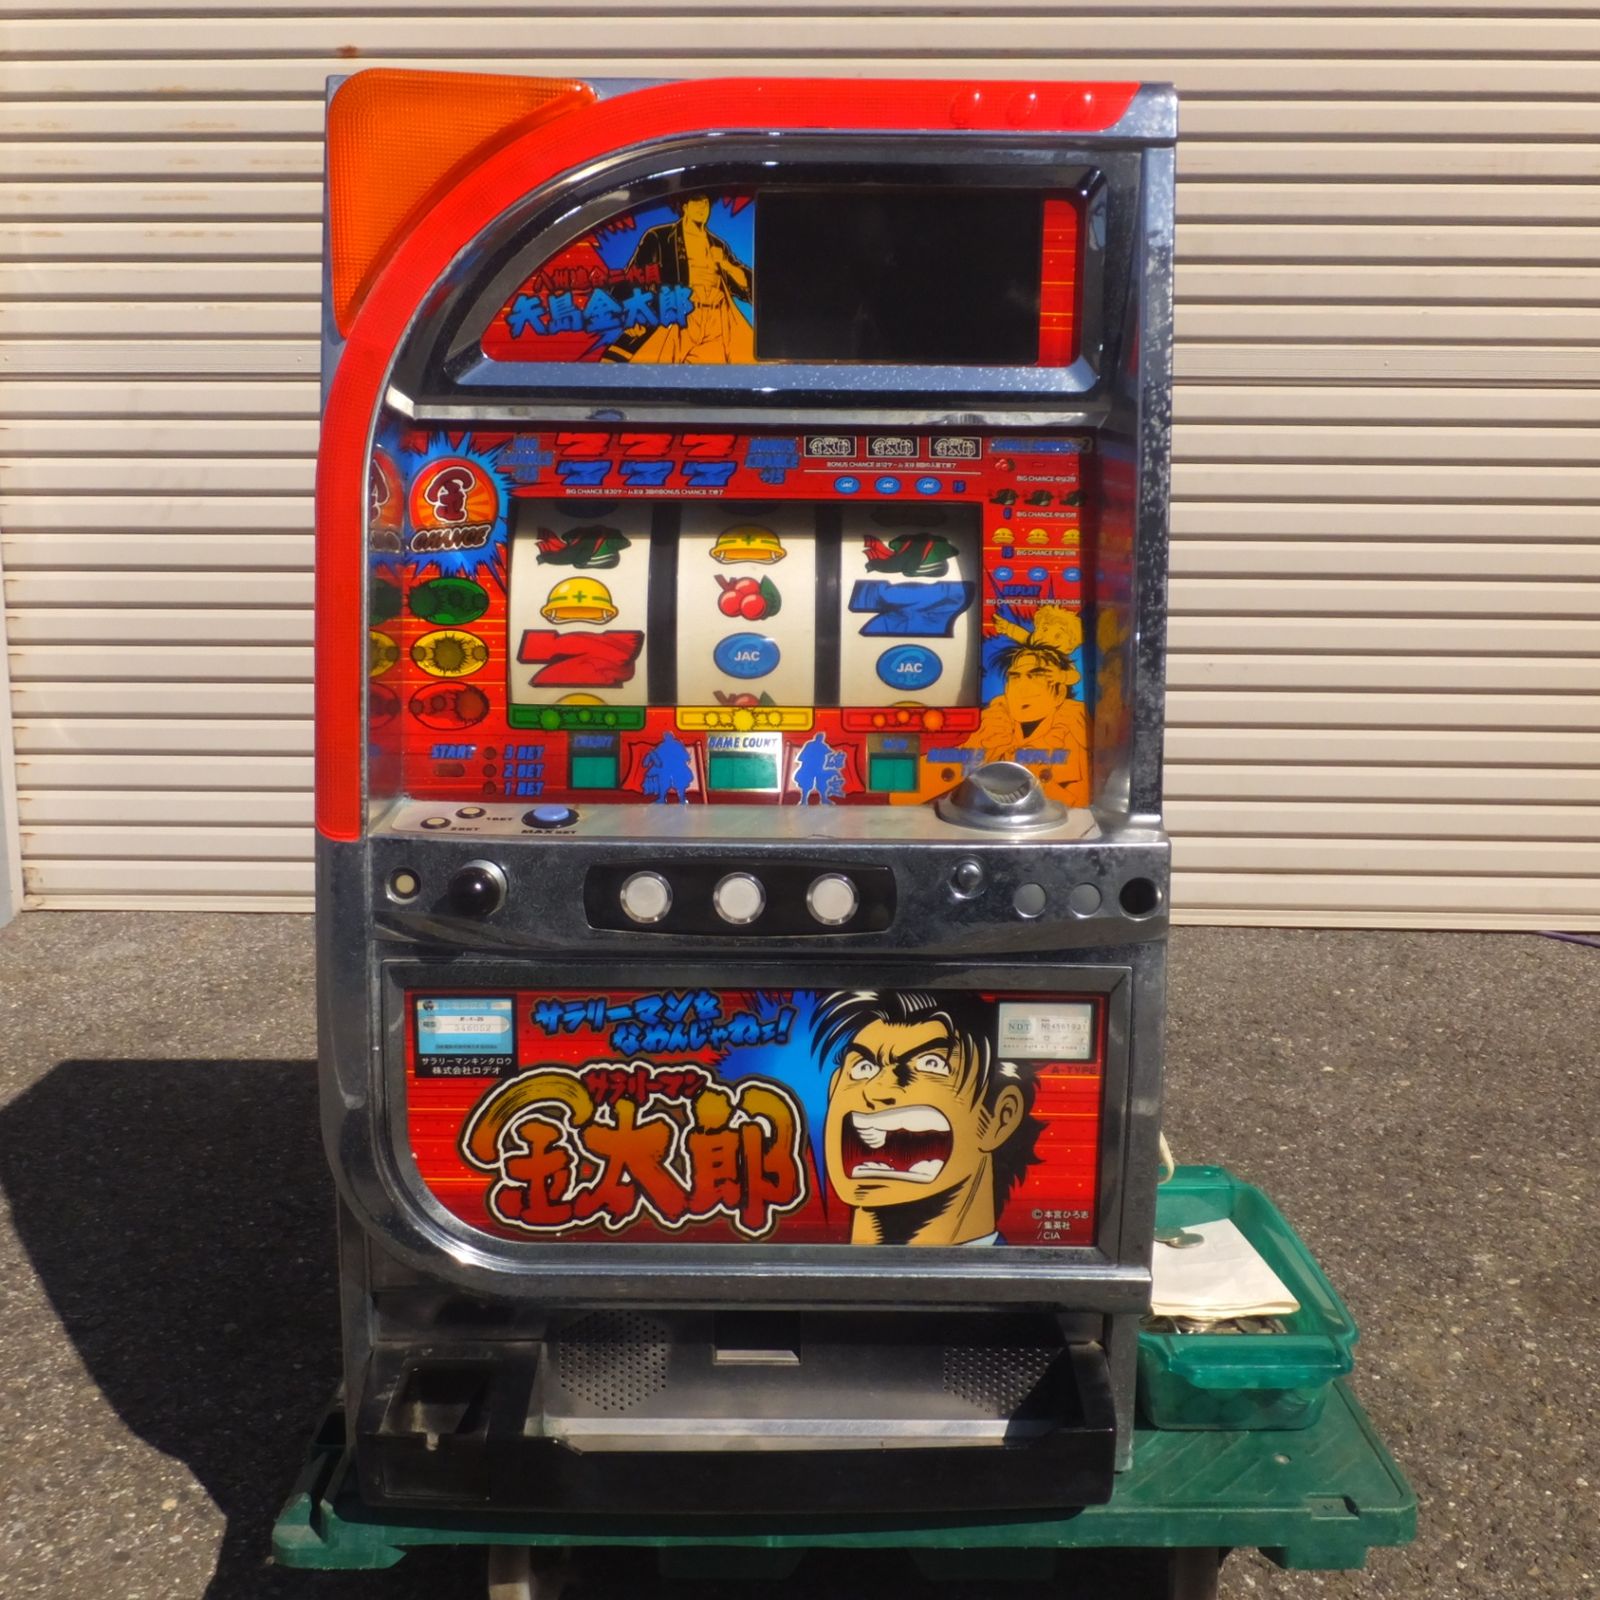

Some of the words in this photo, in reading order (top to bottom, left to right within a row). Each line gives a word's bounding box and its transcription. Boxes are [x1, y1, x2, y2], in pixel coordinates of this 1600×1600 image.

[507, 284, 695, 339] 矢島金太郎
[734, 650, 760, 662] JAC
[896, 662, 922, 674] JAC
[743, 736, 779, 749] COUNT
[431, 744, 477, 760] START
[516, 745, 544, 760] BET
[516, 763, 544, 778] BET
[516, 781, 544, 796] BET
[1008, 1023, 1031, 1031] NDT
[422, 1057, 513, 1066] サラリーマンキンタロウ
[432, 1066, 501, 1075] 株式会社ロデオ
[584, 1066, 706, 1105] サラリーマン
[465, 1072, 801, 1234] 金太郎
